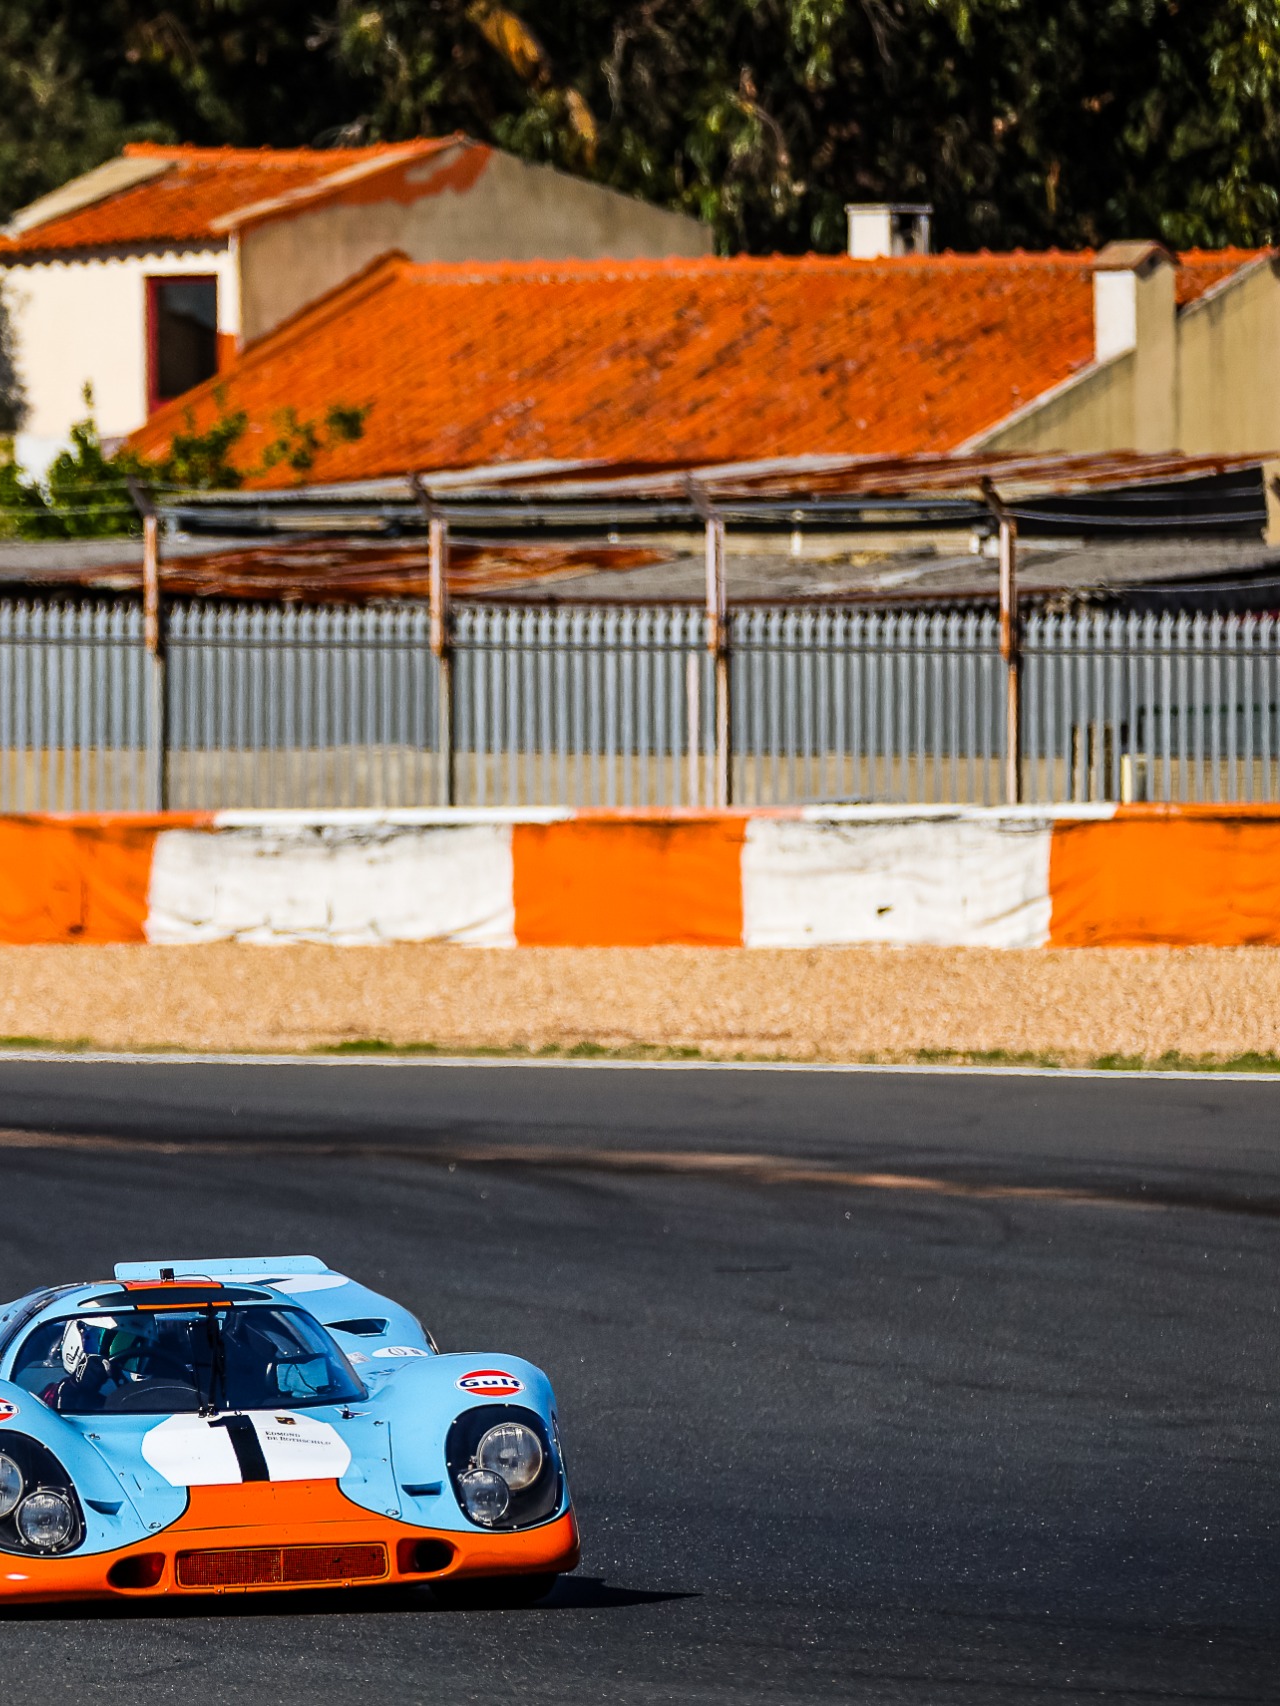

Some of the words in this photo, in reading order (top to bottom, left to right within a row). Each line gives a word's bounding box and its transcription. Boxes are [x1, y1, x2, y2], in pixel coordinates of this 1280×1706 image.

[459, 1378, 521, 1388] Gulf
[265, 1430, 301, 1438] EDMOND
[207, 1414, 271, 1483] 1
